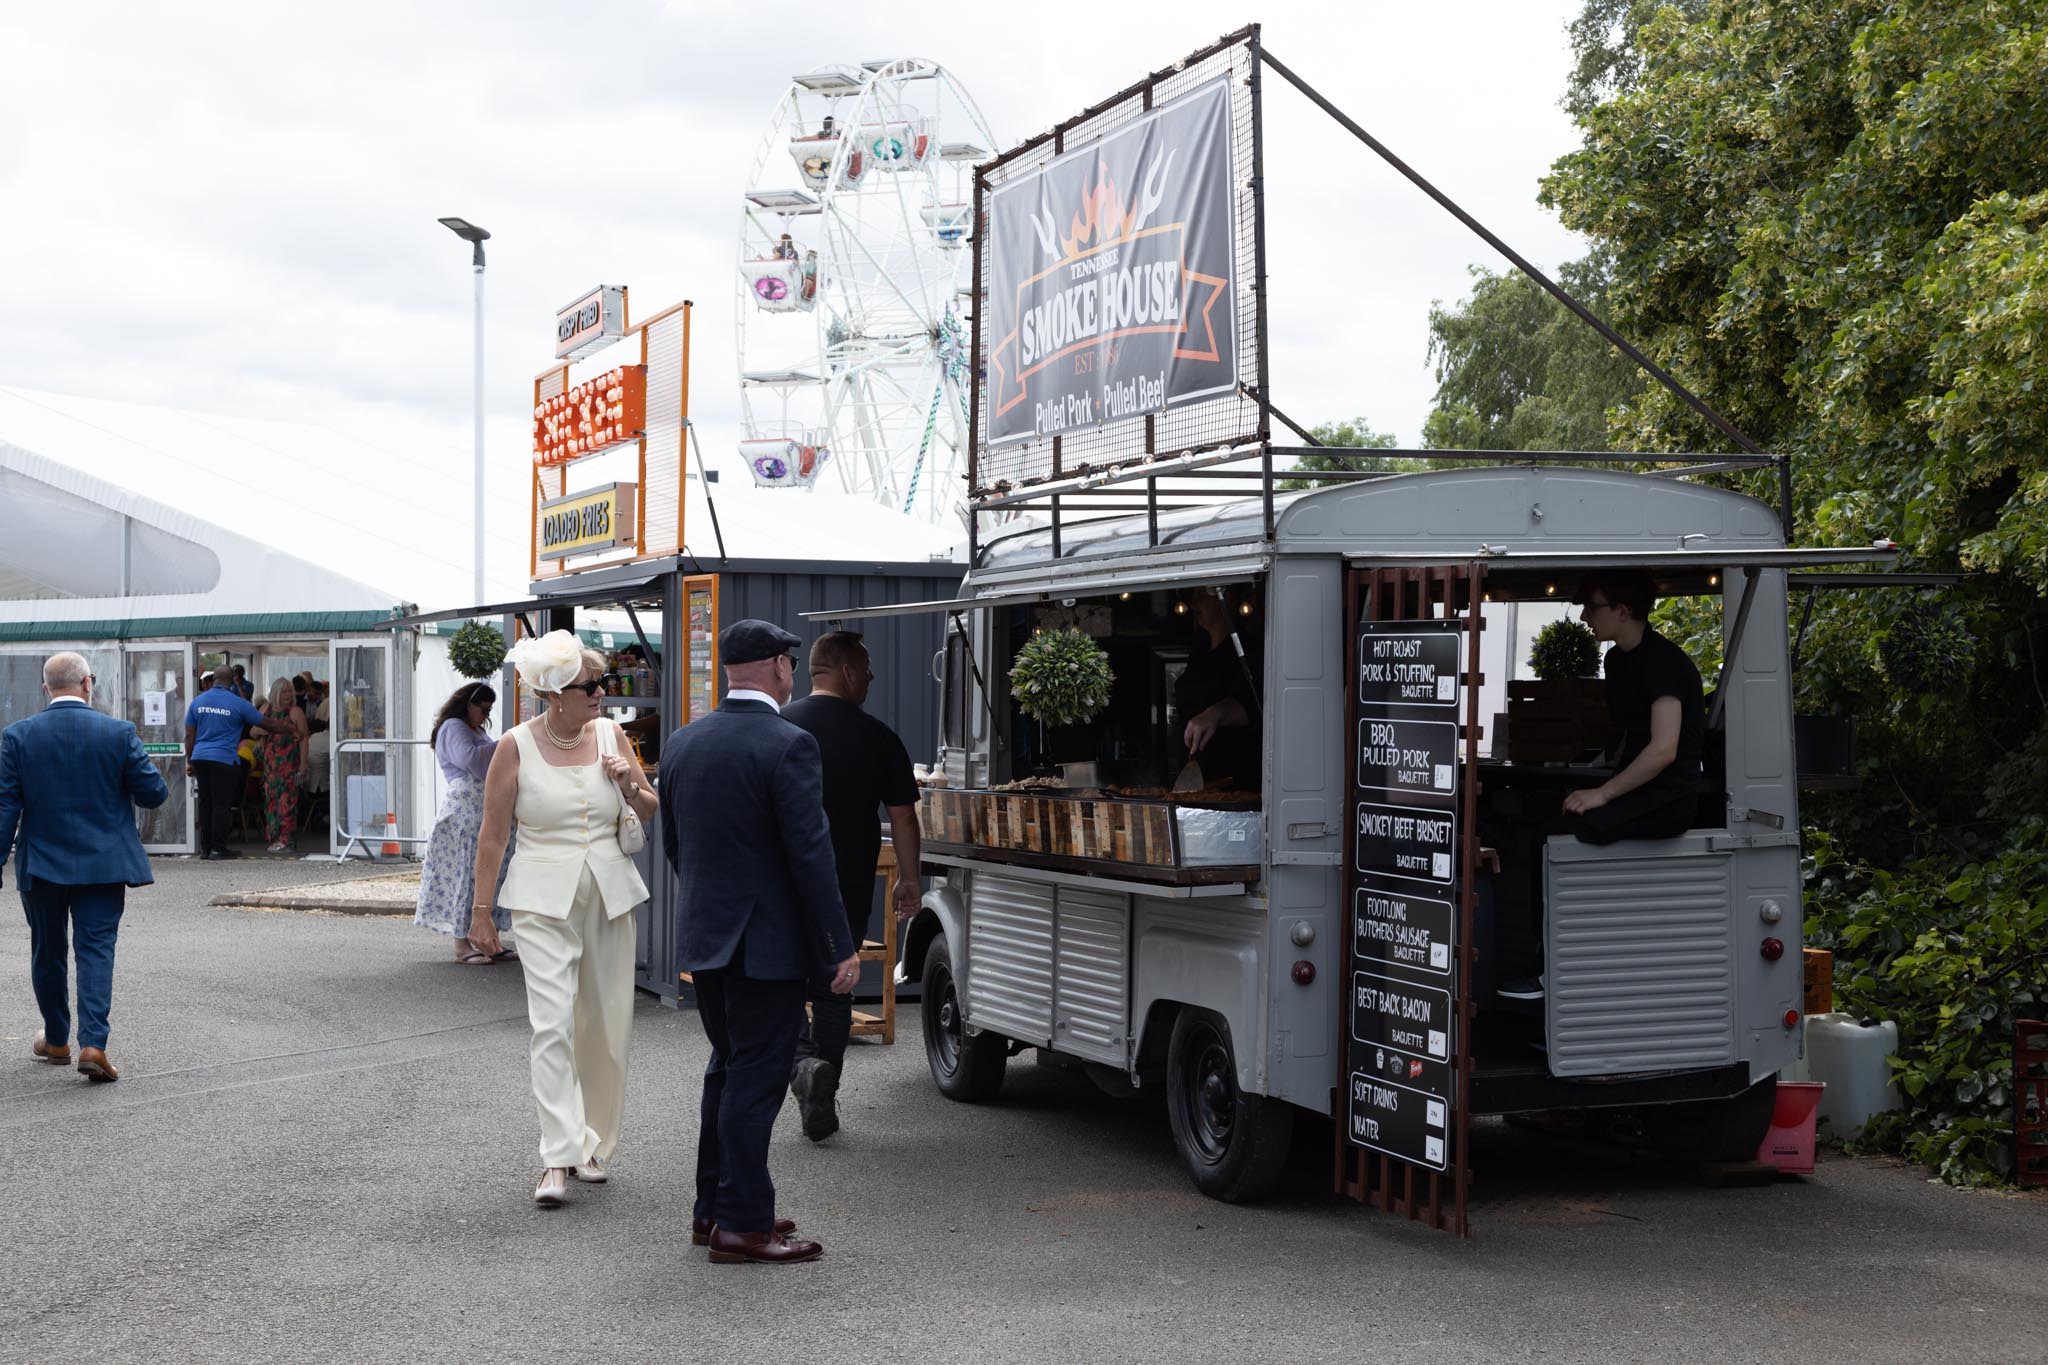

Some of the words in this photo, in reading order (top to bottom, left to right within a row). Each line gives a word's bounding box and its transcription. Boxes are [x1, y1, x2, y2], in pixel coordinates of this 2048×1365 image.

[1071, 248, 1119, 280] TENNESSEE
[558, 310, 581, 342] CRISPY
[581, 301, 599, 331] FRIED
[1022, 280, 1098, 365] SMOKE
[1102, 261, 1178, 333] HOUSE
[1036, 396, 1066, 434] Pulled
[1068, 390, 1092, 427] Pork
[1103, 375, 1135, 418] Pulled
[1139, 370, 1165, 410] Beef
[543, 509, 580, 547] LOADED
[582, 500, 609, 538] FRIES
[1373, 641, 1392, 658] HOT
[1393, 640, 1422, 658] ROAST
[1362, 664, 1384, 682] PORK
[1385, 663, 1391, 682] &
[1393, 663, 1435, 683] STUFFING
[197, 706, 231, 716] STEWARD
[1371, 723, 1395, 747] BBQ
[1363, 747, 1400, 767] PULLED
[1403, 749, 1430, 769] PORK
[1360, 812, 1393, 837] SMOKEY
[1394, 816, 1415, 840] BEEF
[1416, 819, 1451, 844] BRISKET
[1367, 897, 1407, 921] FOOTLONG
[1358, 918, 1394, 942] BUTCHERS
[1395, 924, 1430, 948] SAUSAGE
[1357, 986, 1378, 1011] BEST
[1379, 991, 1400, 1016] BACK
[1402, 996, 1431, 1023] BACON
[1354, 1080, 1372, 1103] SOFT
[1373, 1086, 1398, 1112] DRINKS
[1354, 1114, 1379, 1141] WATER
